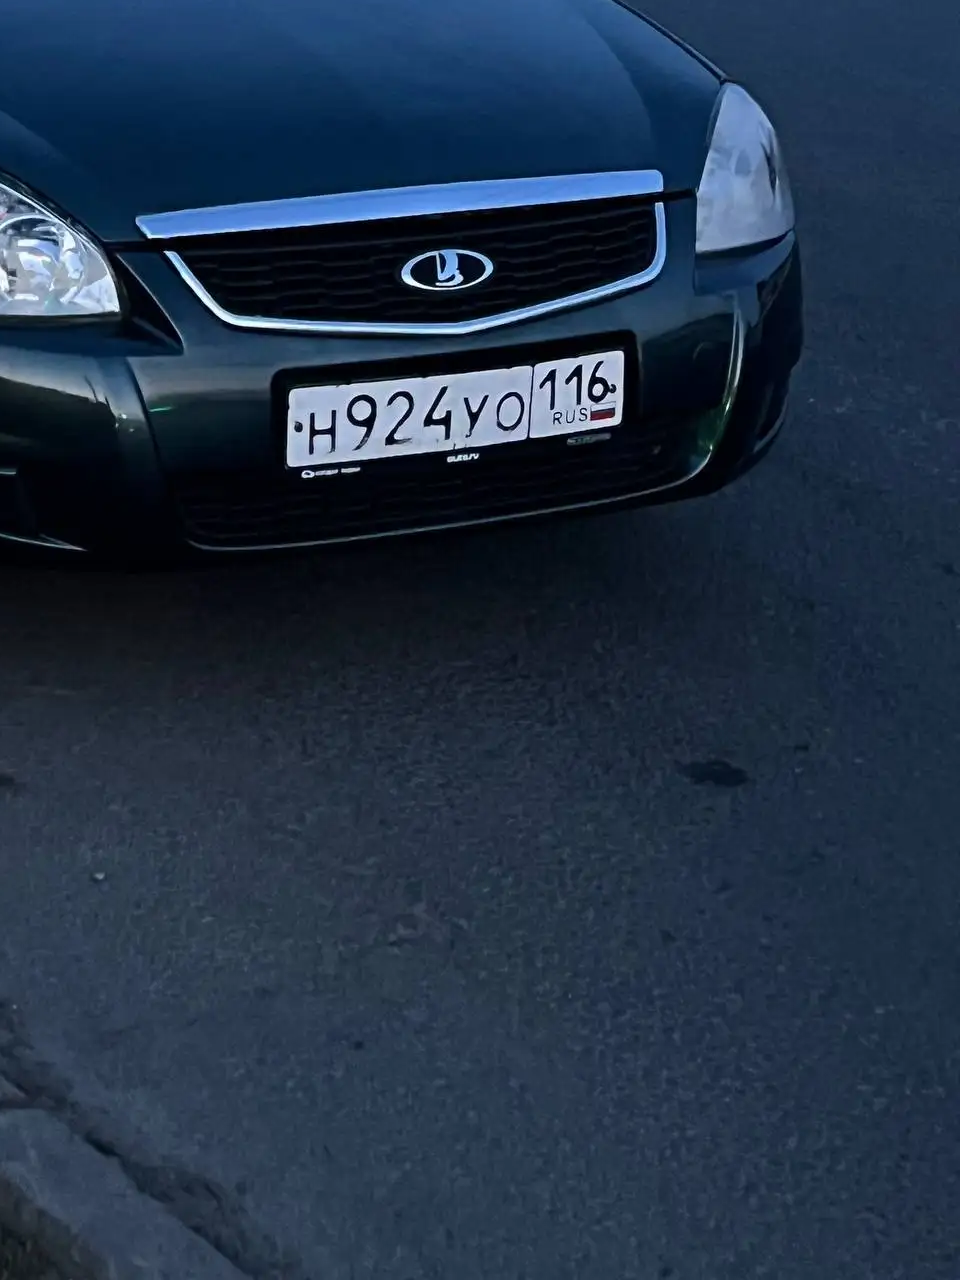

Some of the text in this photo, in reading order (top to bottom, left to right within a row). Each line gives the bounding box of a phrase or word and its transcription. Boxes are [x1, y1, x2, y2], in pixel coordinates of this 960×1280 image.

[308, 360, 609, 455] Н924УО 116
[552, 407, 588, 425] RUS
